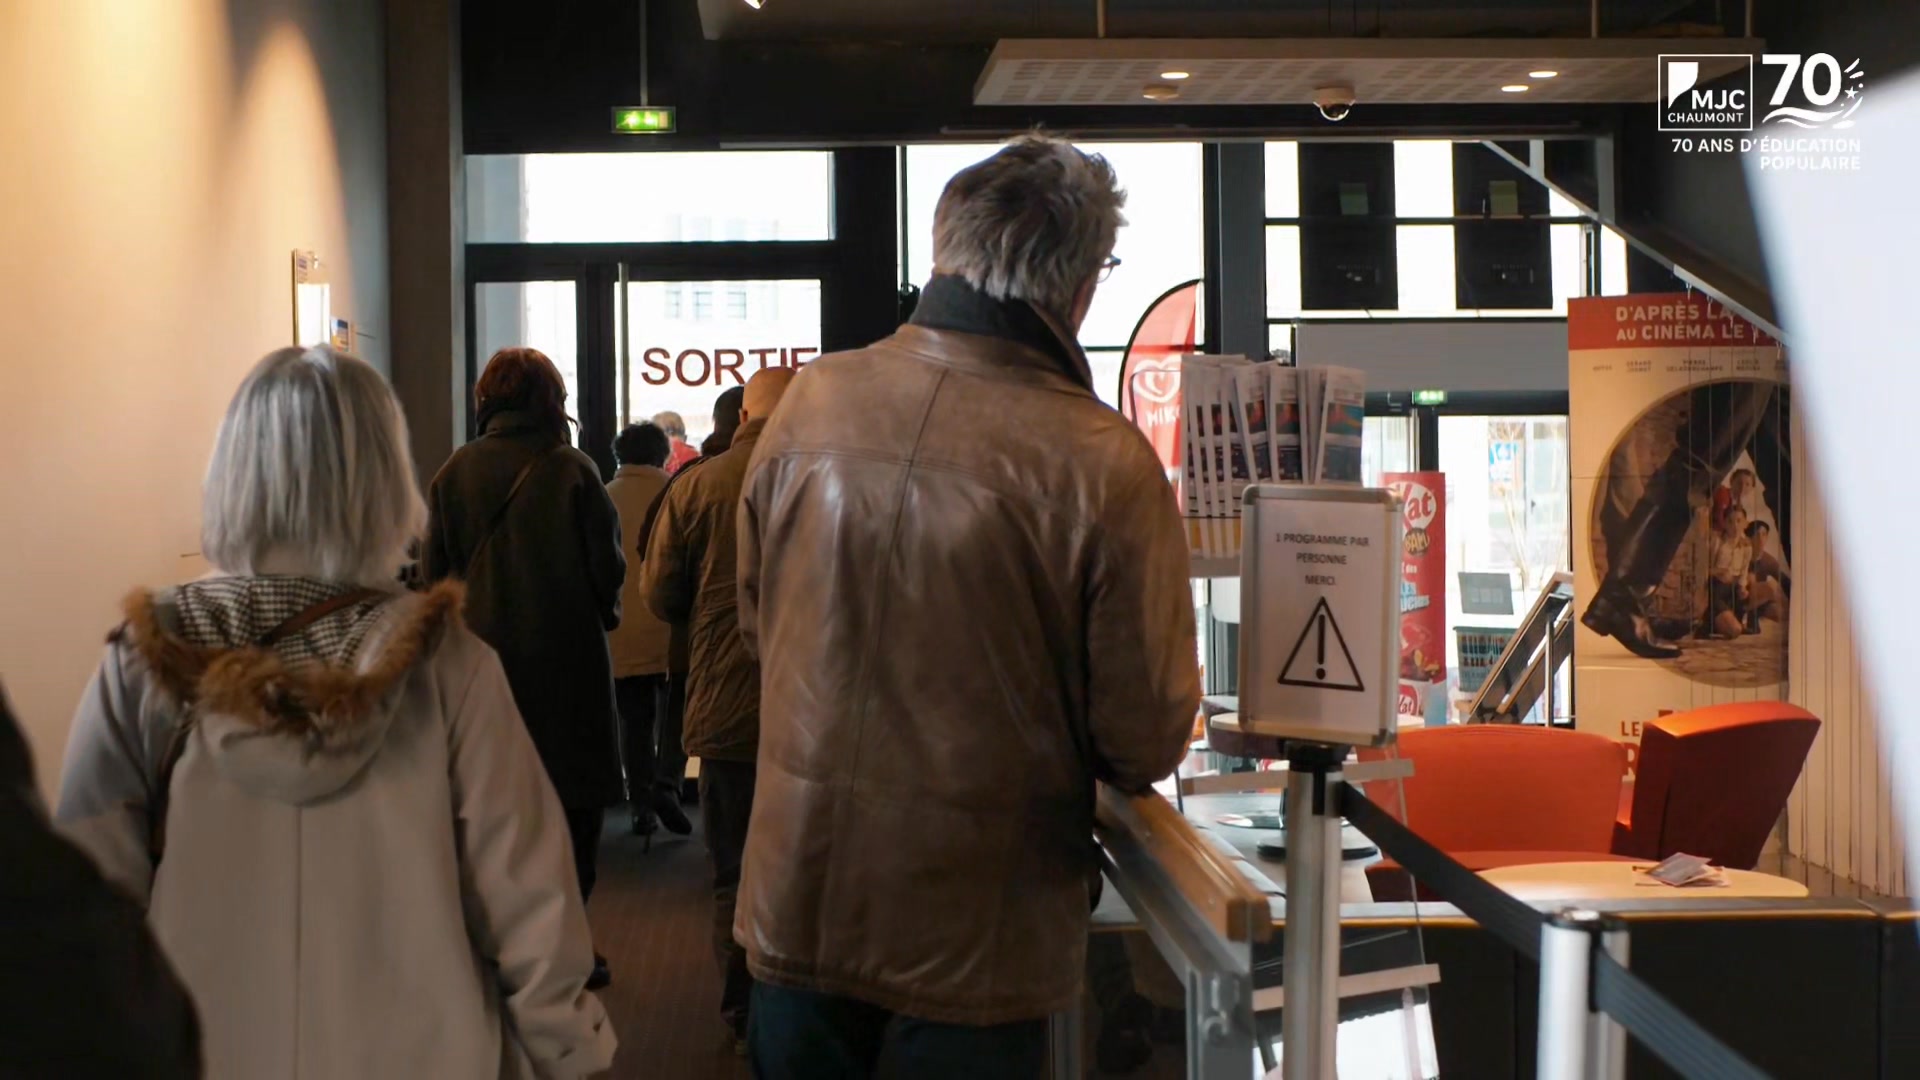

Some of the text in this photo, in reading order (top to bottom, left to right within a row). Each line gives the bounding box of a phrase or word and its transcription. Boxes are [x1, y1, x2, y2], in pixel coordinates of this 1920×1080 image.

[1616, 301, 1700, 322] D'APRÈS
[1616, 328, 1636, 341] AU
[1642, 321, 1715, 340] CINÉMA
[1722, 324, 1744, 339] LE
[1276, 533, 1369, 547] 1 PROGRAMME PAR
[1296, 552, 1347, 565] PERSONNE
